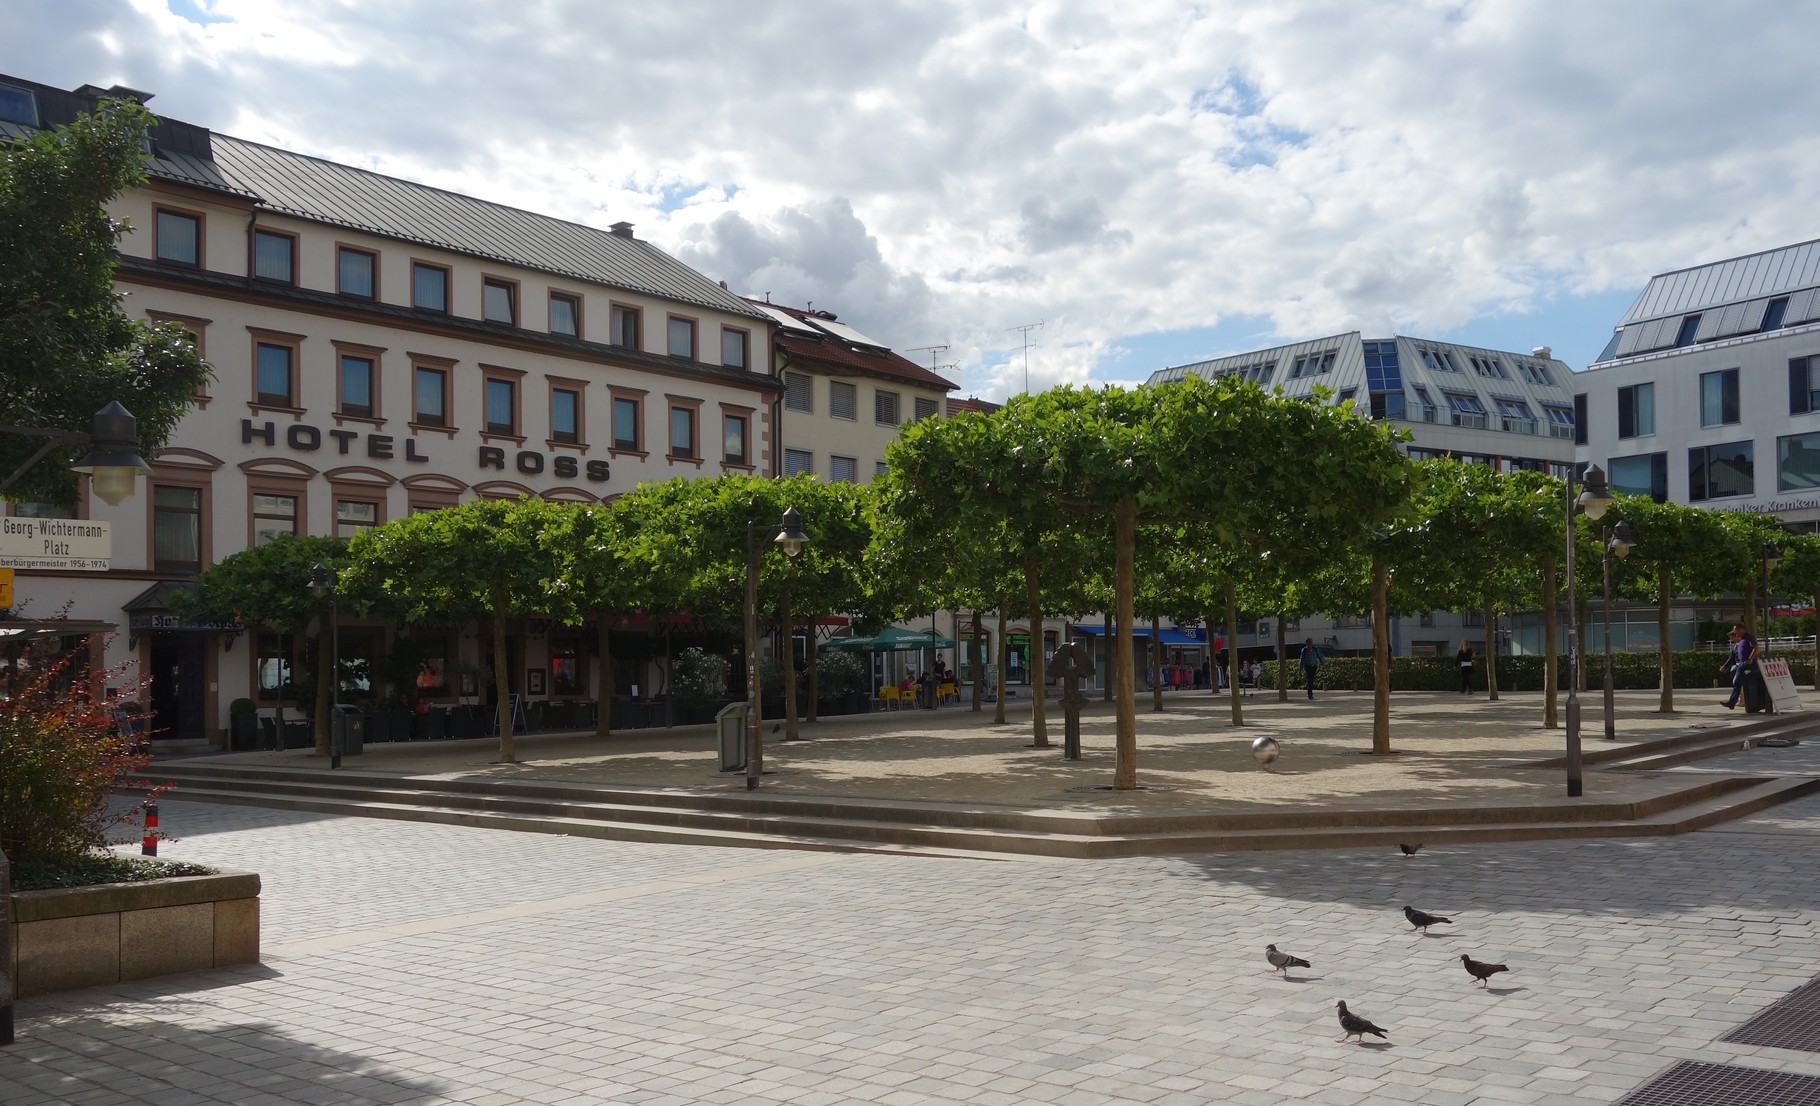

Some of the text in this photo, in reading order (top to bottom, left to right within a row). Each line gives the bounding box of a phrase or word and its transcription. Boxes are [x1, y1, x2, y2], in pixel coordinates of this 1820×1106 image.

[241, 418, 611, 482] HOTEL ROSS
[4, 518, 107, 539] Georg-Wichtermann-
[44, 539, 70, 556] Platz
[0, 558, 107, 569] berbürgermeister 1956-1974
